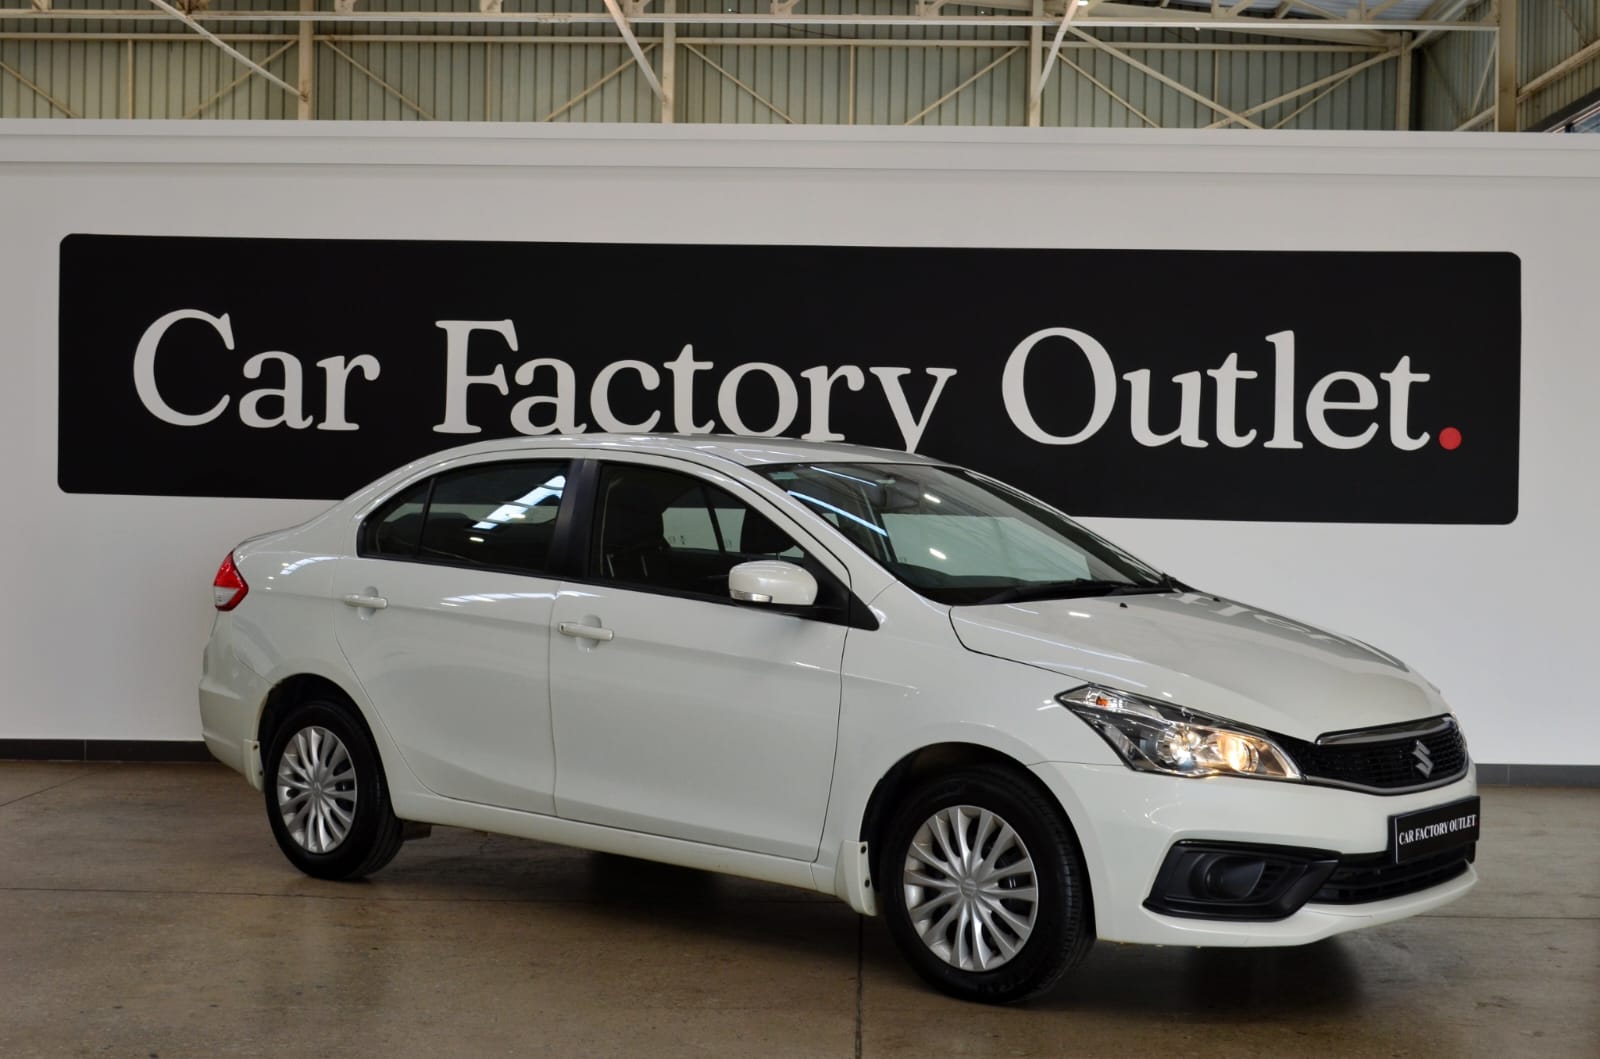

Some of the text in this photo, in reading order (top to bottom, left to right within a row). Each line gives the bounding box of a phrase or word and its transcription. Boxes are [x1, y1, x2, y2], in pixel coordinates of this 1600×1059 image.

[133, 309, 1463, 454] Car Factory Outlet.
[1398, 830, 1415, 846] CAR
[1415, 822, 1450, 841] FACTORY
